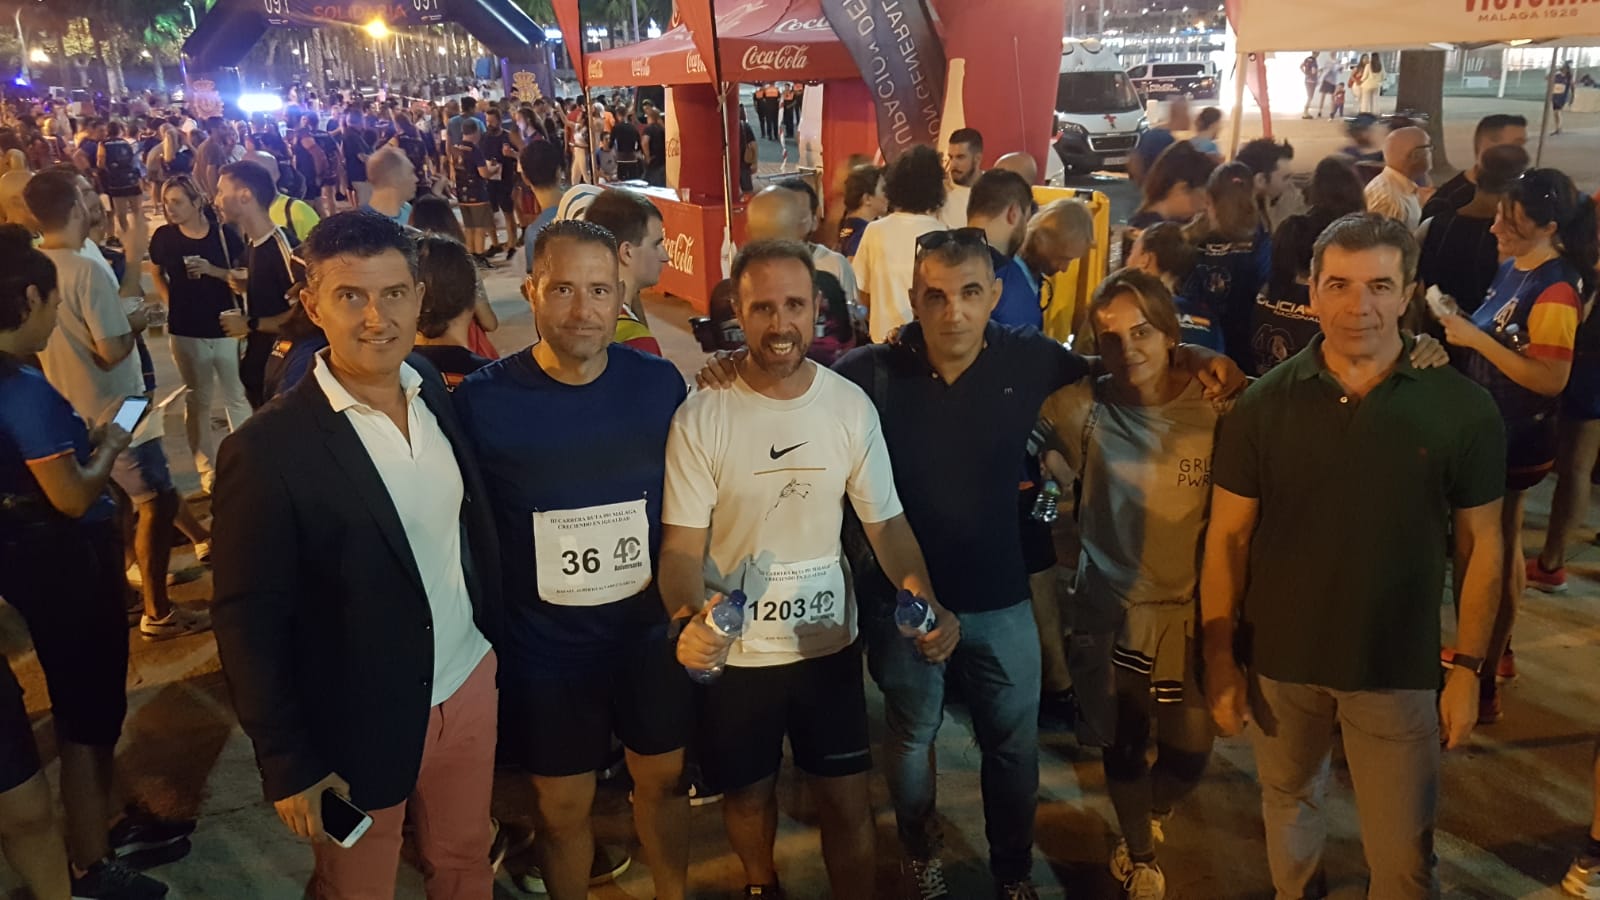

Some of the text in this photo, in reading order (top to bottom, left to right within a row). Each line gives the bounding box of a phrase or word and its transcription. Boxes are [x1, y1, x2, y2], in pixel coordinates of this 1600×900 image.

[1544, 8, 1579, 18] 1928
[742, 44, 809, 71] Coca-Cola
[1179, 458, 1212, 473] GRL
[562, 548, 600, 575] 36
[613, 536, 641, 563] 40
[748, 598, 806, 621] 1203
